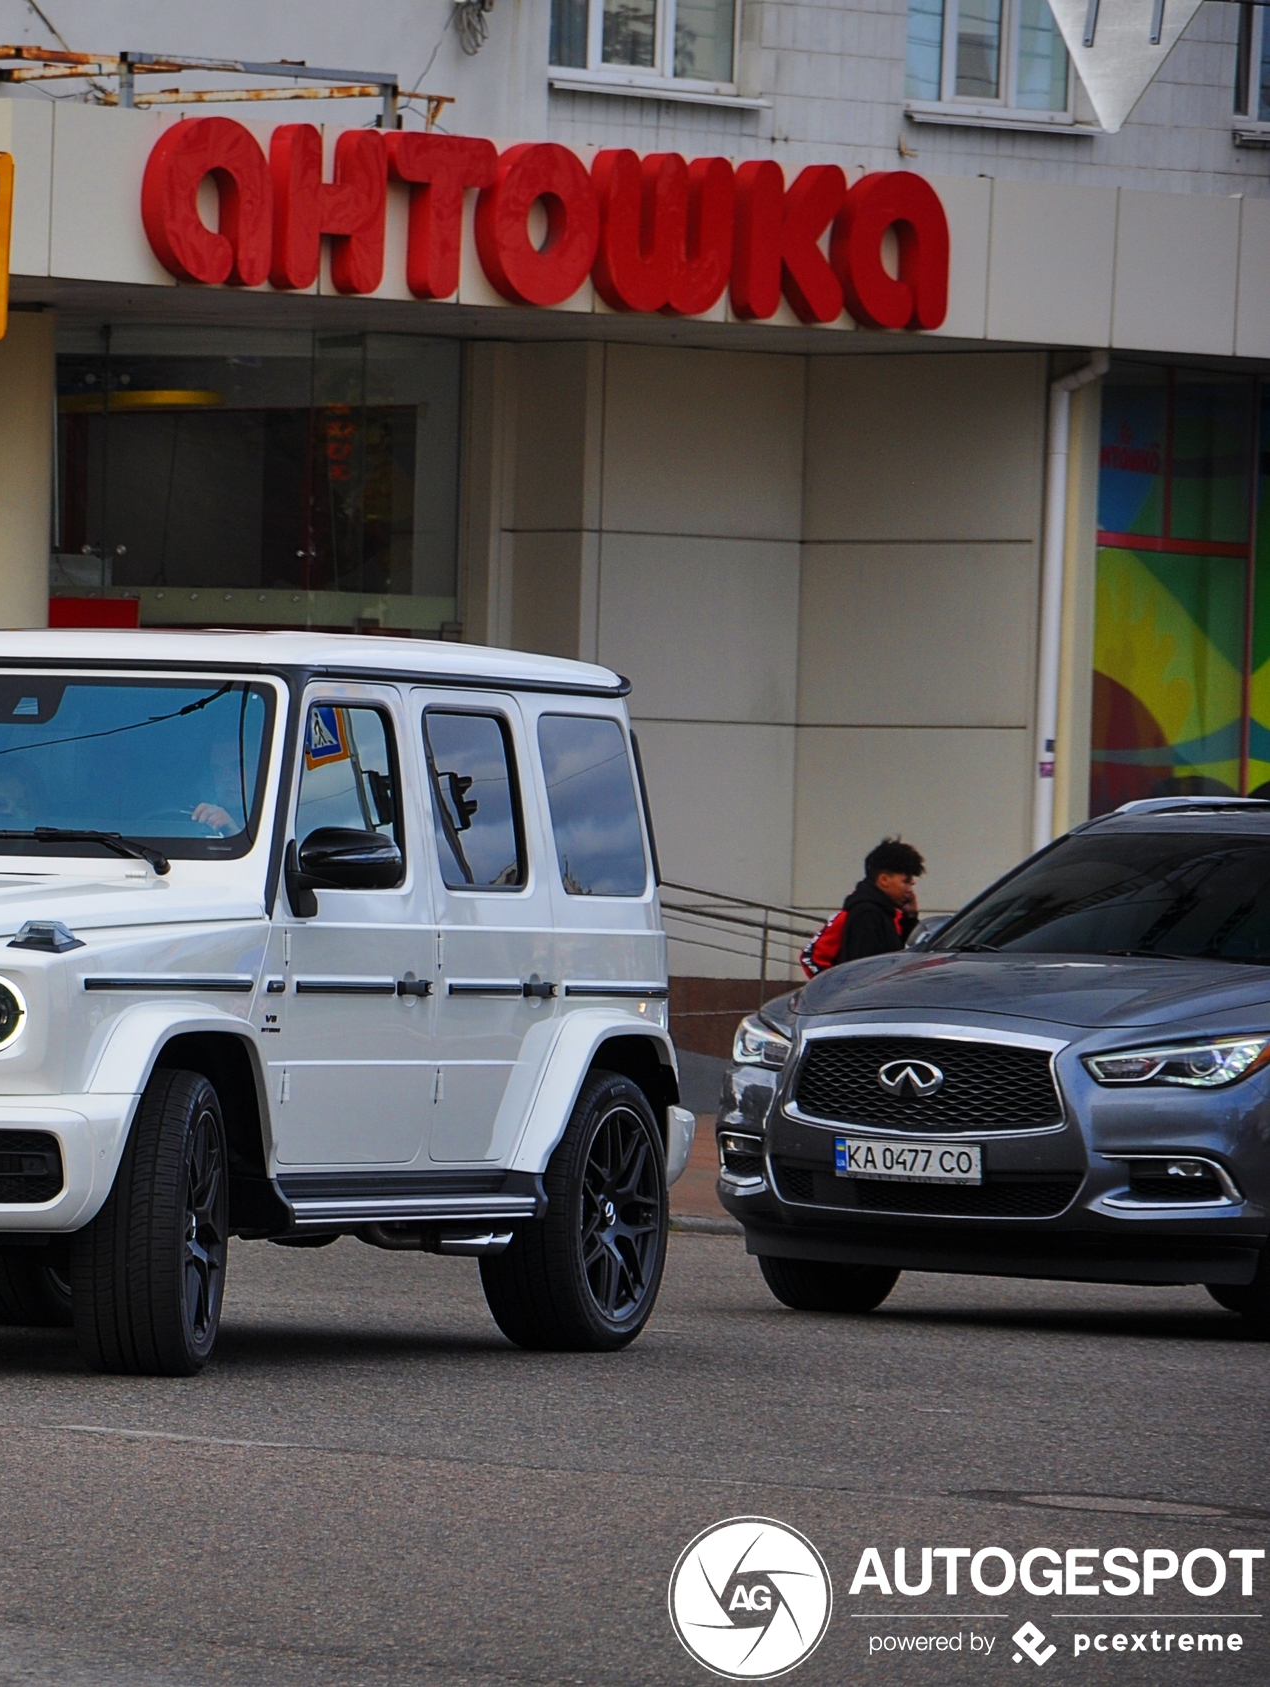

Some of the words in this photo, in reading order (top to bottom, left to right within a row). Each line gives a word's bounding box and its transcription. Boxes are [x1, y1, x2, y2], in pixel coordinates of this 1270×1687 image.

[848, 1144, 878, 1170] KA
[882, 1147, 932, 1173] 0477
[939, 1150, 973, 1174] CO
